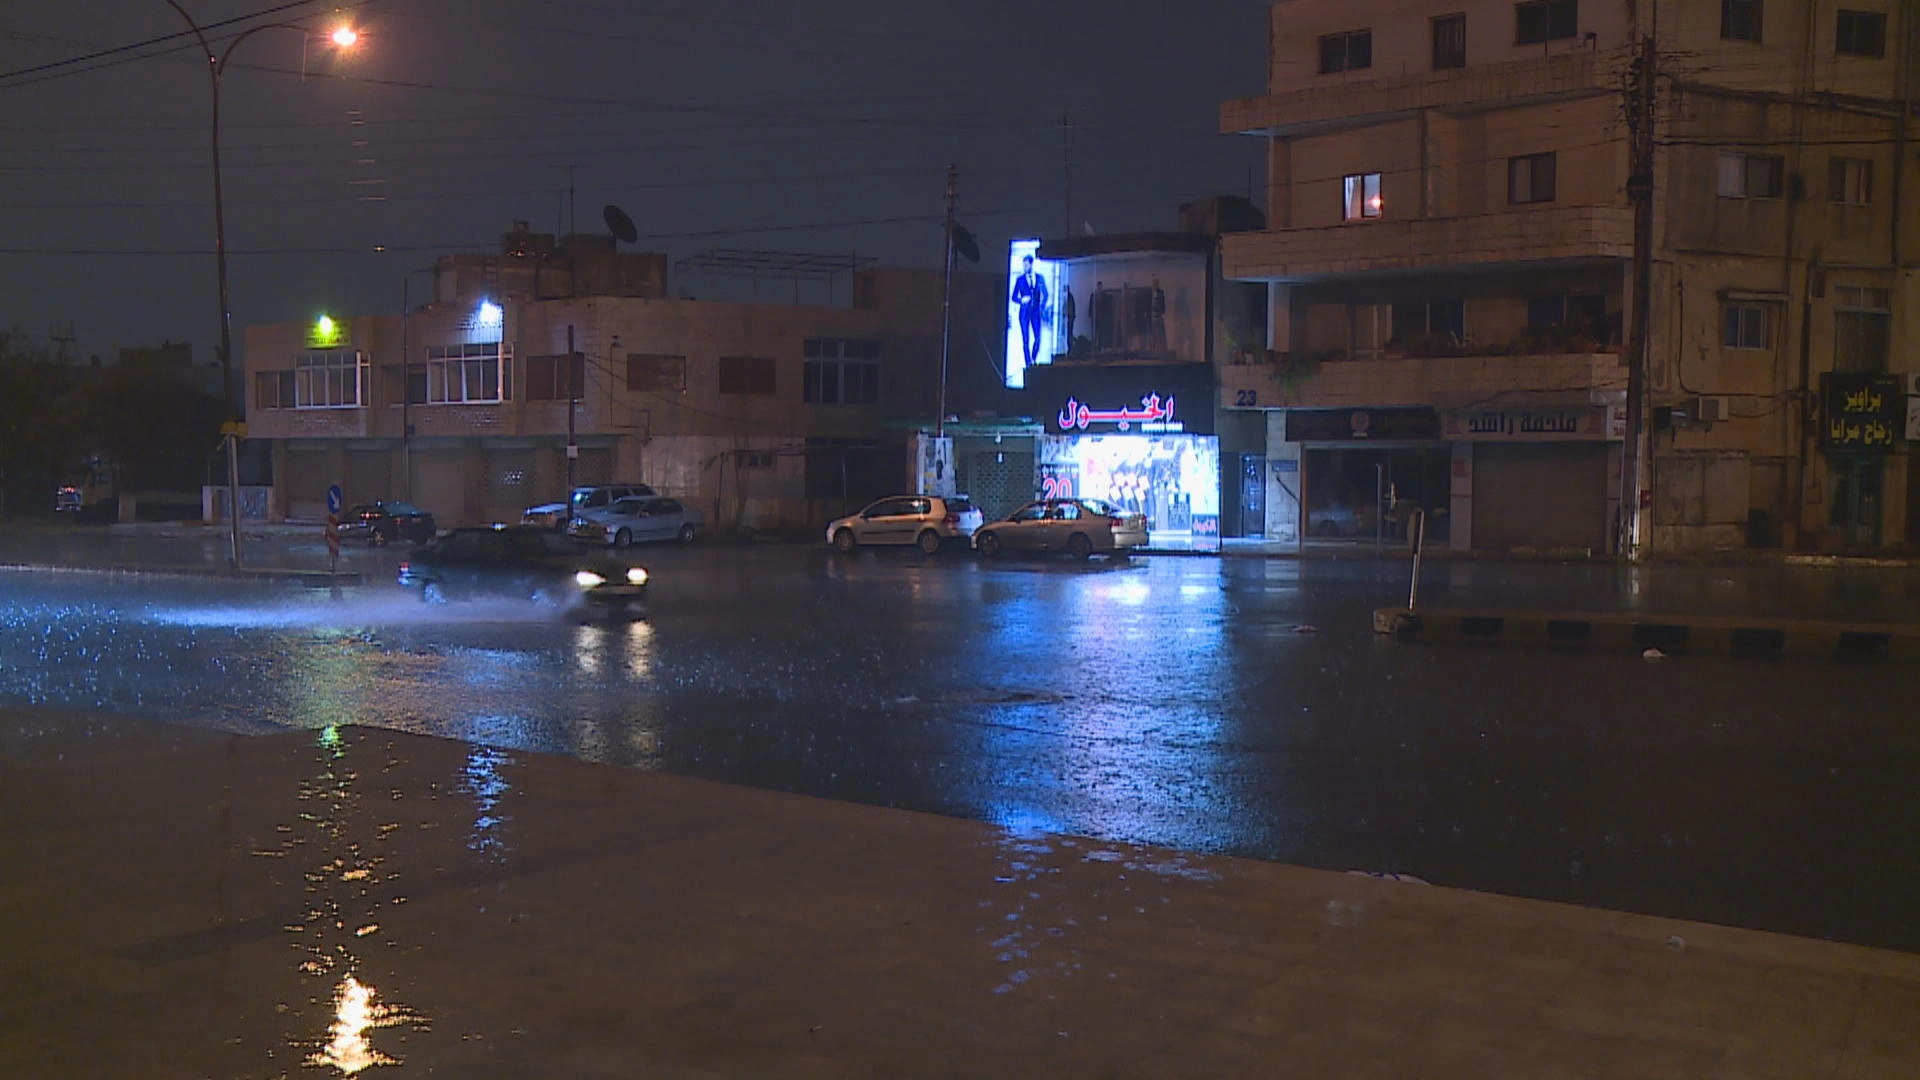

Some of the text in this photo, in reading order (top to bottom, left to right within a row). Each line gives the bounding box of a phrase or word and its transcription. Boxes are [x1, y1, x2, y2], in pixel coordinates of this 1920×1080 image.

[1058, 392, 1175, 430] الخيول
[1237, 389, 1257, 406] 23
[1842, 386, 1882, 413] براويز
[1468, 411, 1577, 436] ملحمة راشد
[1830, 418, 1893, 446] زجاج مرايا
